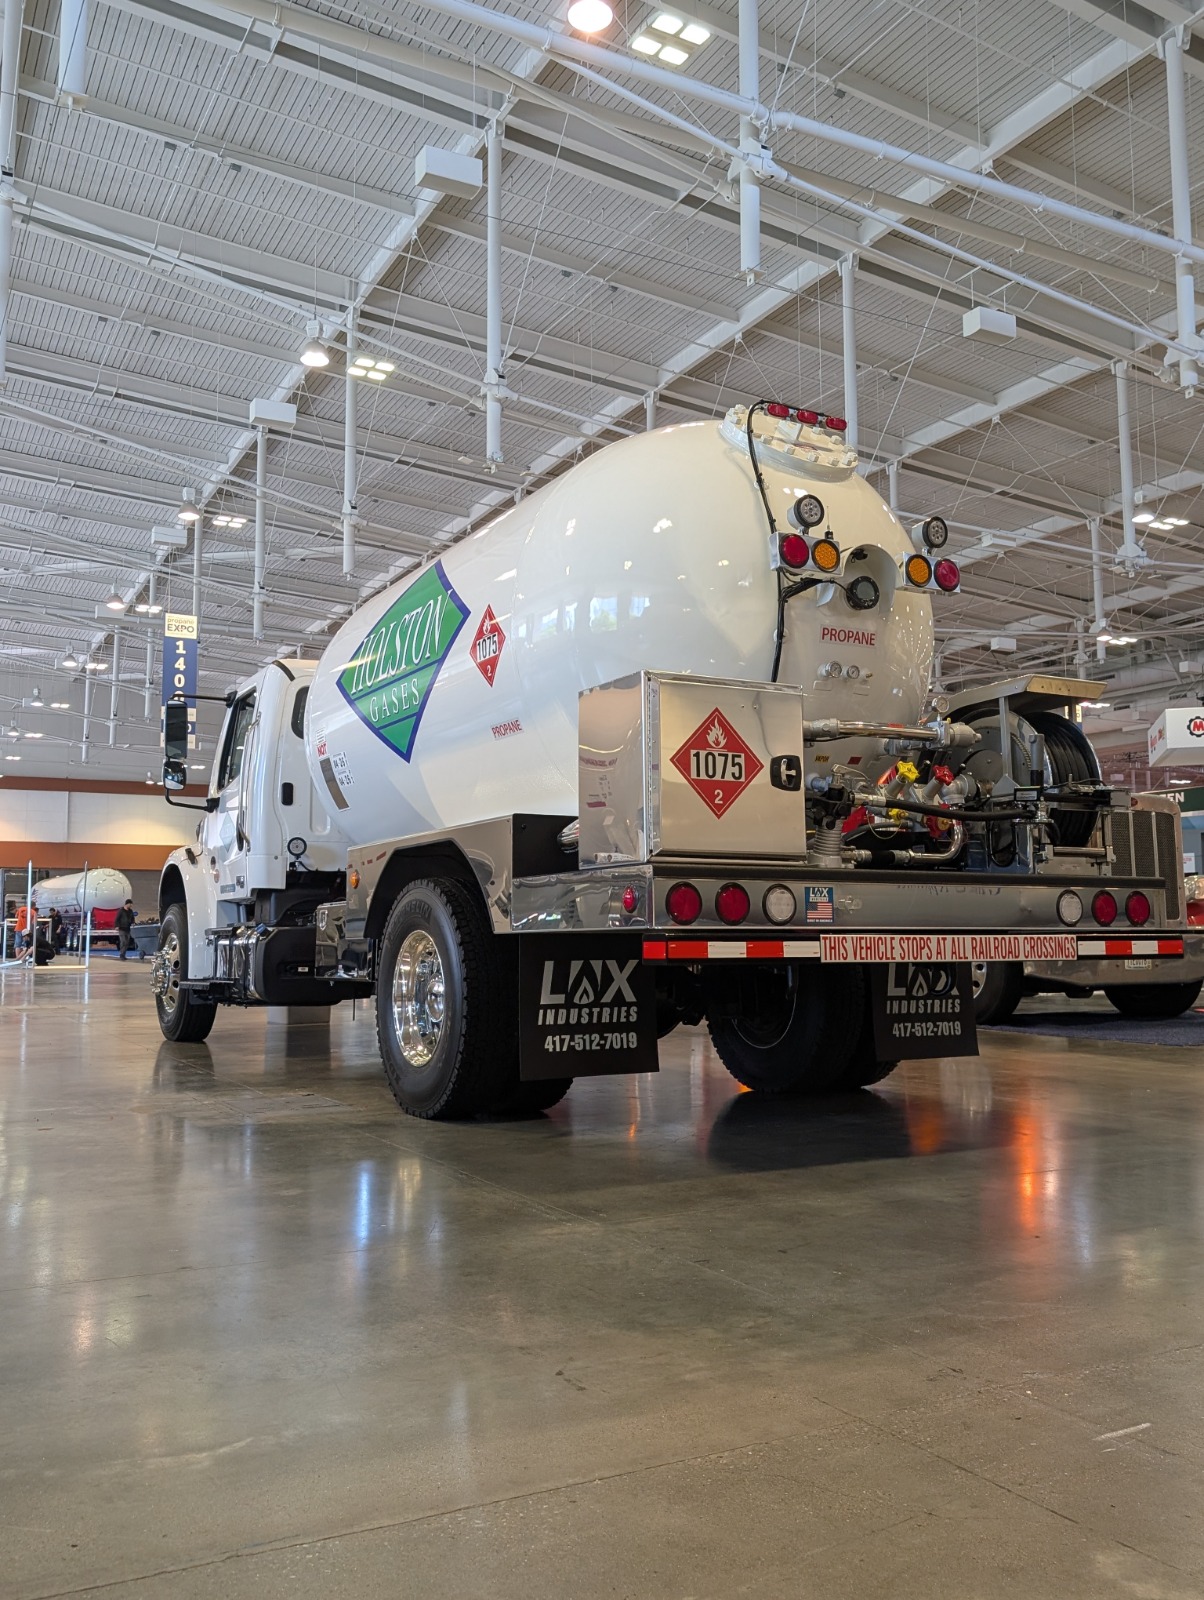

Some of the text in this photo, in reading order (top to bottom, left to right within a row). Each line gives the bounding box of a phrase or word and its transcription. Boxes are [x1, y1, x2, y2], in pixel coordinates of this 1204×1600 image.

[167, 623, 195, 633] EXPO
[821, 627, 876, 646] PROPANE
[350, 588, 453, 695] HOLSTON
[477, 633, 498, 660] 1075
[486, 664, 492, 677] 2
[369, 678, 420, 722] GASES
[491, 719, 523, 739] PROPANE
[692, 750, 743, 780] 1075
[714, 789, 724, 804] 2
[821, 936, 1076, 961] THIS VEHICLE STOPS AT ALL RAILROAD CROSSINGS
[538, 1006, 638, 1026] INDUSTRIES
[886, 999, 960, 1014] INDUSTRIES
[892, 1021, 962, 1038] 417-512-7019
[544, 1031, 638, 1052] 417-512-7019
